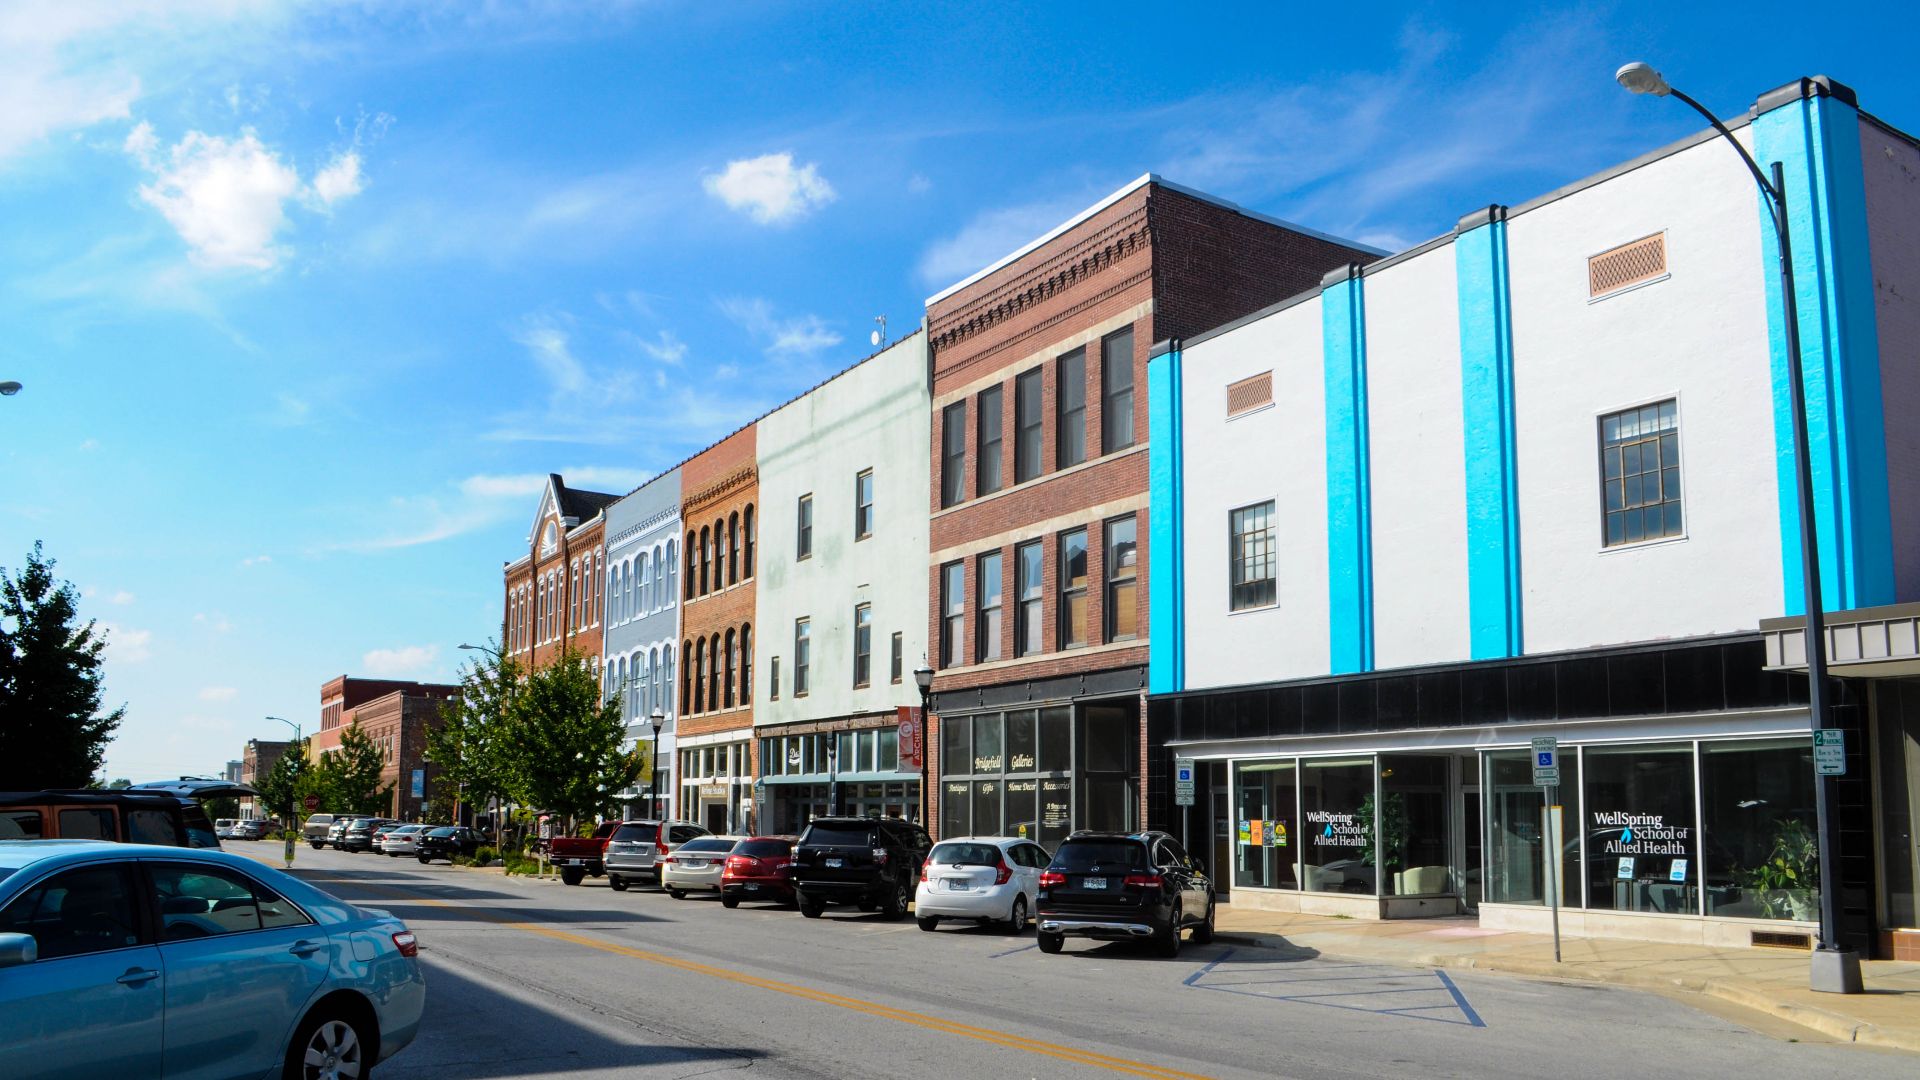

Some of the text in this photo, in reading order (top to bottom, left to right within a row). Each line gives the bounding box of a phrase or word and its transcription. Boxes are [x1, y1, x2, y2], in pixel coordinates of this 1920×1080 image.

[1815, 733, 1822, 745] 2
[975, 753, 1034, 771] Bridgefield Galleries
[948, 783, 968, 795] Antiques
[982, 783, 994, 794] Gifts
[1008, 782, 1037, 791] Home Decor
[1042, 781, 1071, 791] Accessories
[1307, 811, 1353, 826] WellSpring
[1594, 812, 1663, 829] WellSpring
[1333, 823, 1369, 834] School of
[1633, 826, 1688, 840] School of
[1313, 834, 1367, 847] Allied Health
[1605, 840, 1686, 855] Allied Health
